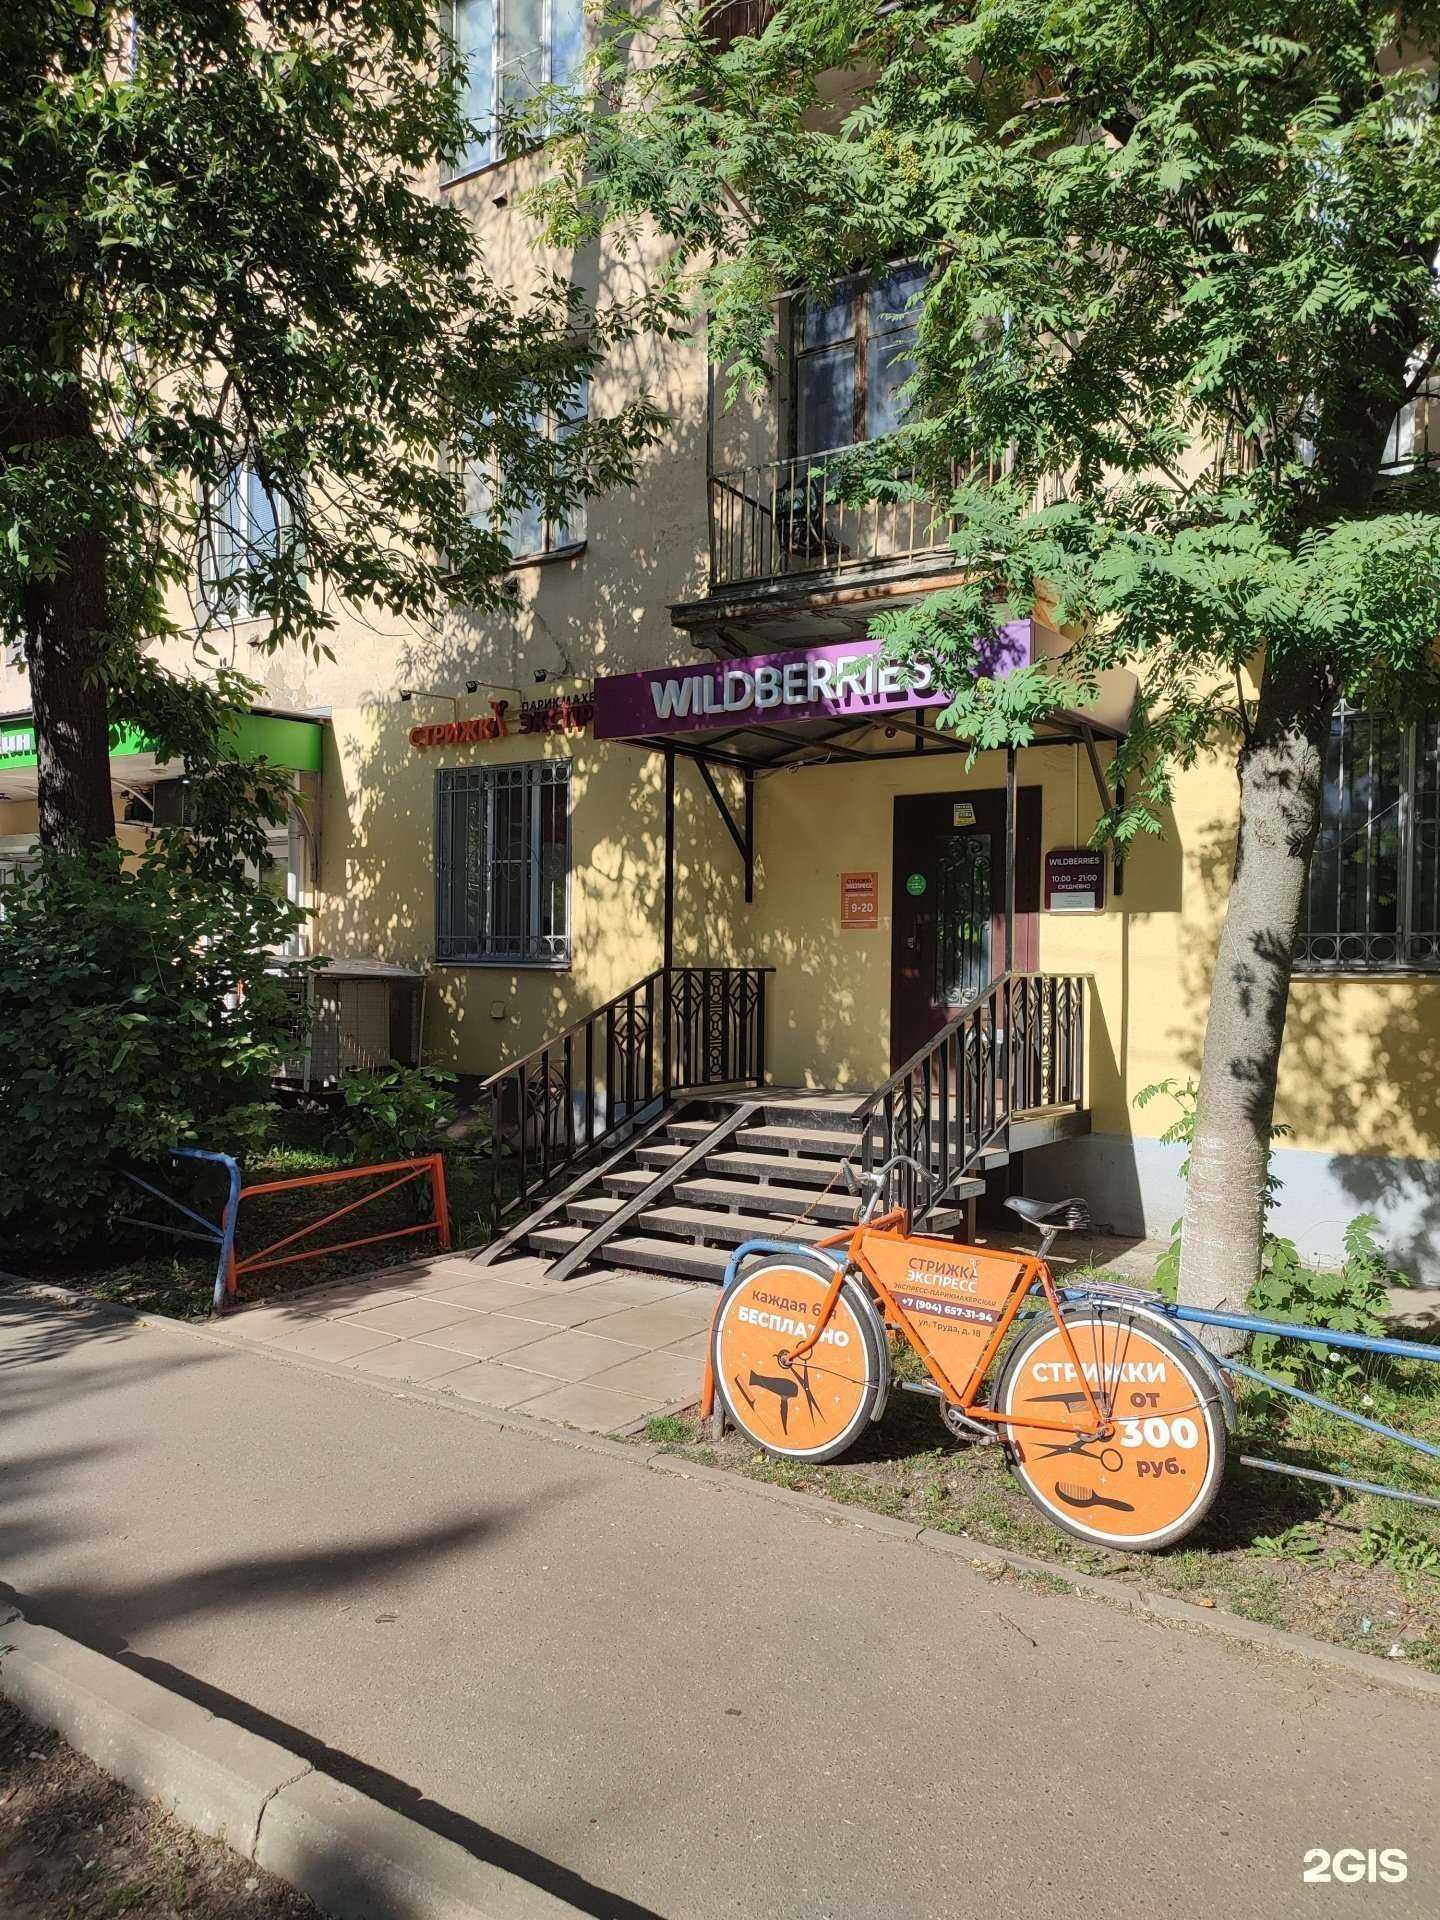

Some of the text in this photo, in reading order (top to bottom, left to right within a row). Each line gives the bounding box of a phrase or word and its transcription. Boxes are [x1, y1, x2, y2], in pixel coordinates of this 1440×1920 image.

[651, 656, 932, 719] WILDBERRIES
[1049, 856, 1100, 866] WILDBERRIES
[1052, 875, 1071, 883] 10:00
[1078, 874, 1098, 882] 21:00
[851, 903, 874, 913] 9-20
[907, 1270, 977, 1293] ЭКСПРЕСС
[752, 1289, 807, 1314] каждая
[902, 1298, 993, 1323] +7 (904) 657-31-94
[932, 1321, 960, 1335] Труда,
[972, 1328, 981, 1337] 18
[1032, 1361, 1166, 1384] СТРИЖКИ
[1118, 1417, 1199, 1449] 300
[1136, 1456, 1187, 1478] руб.
